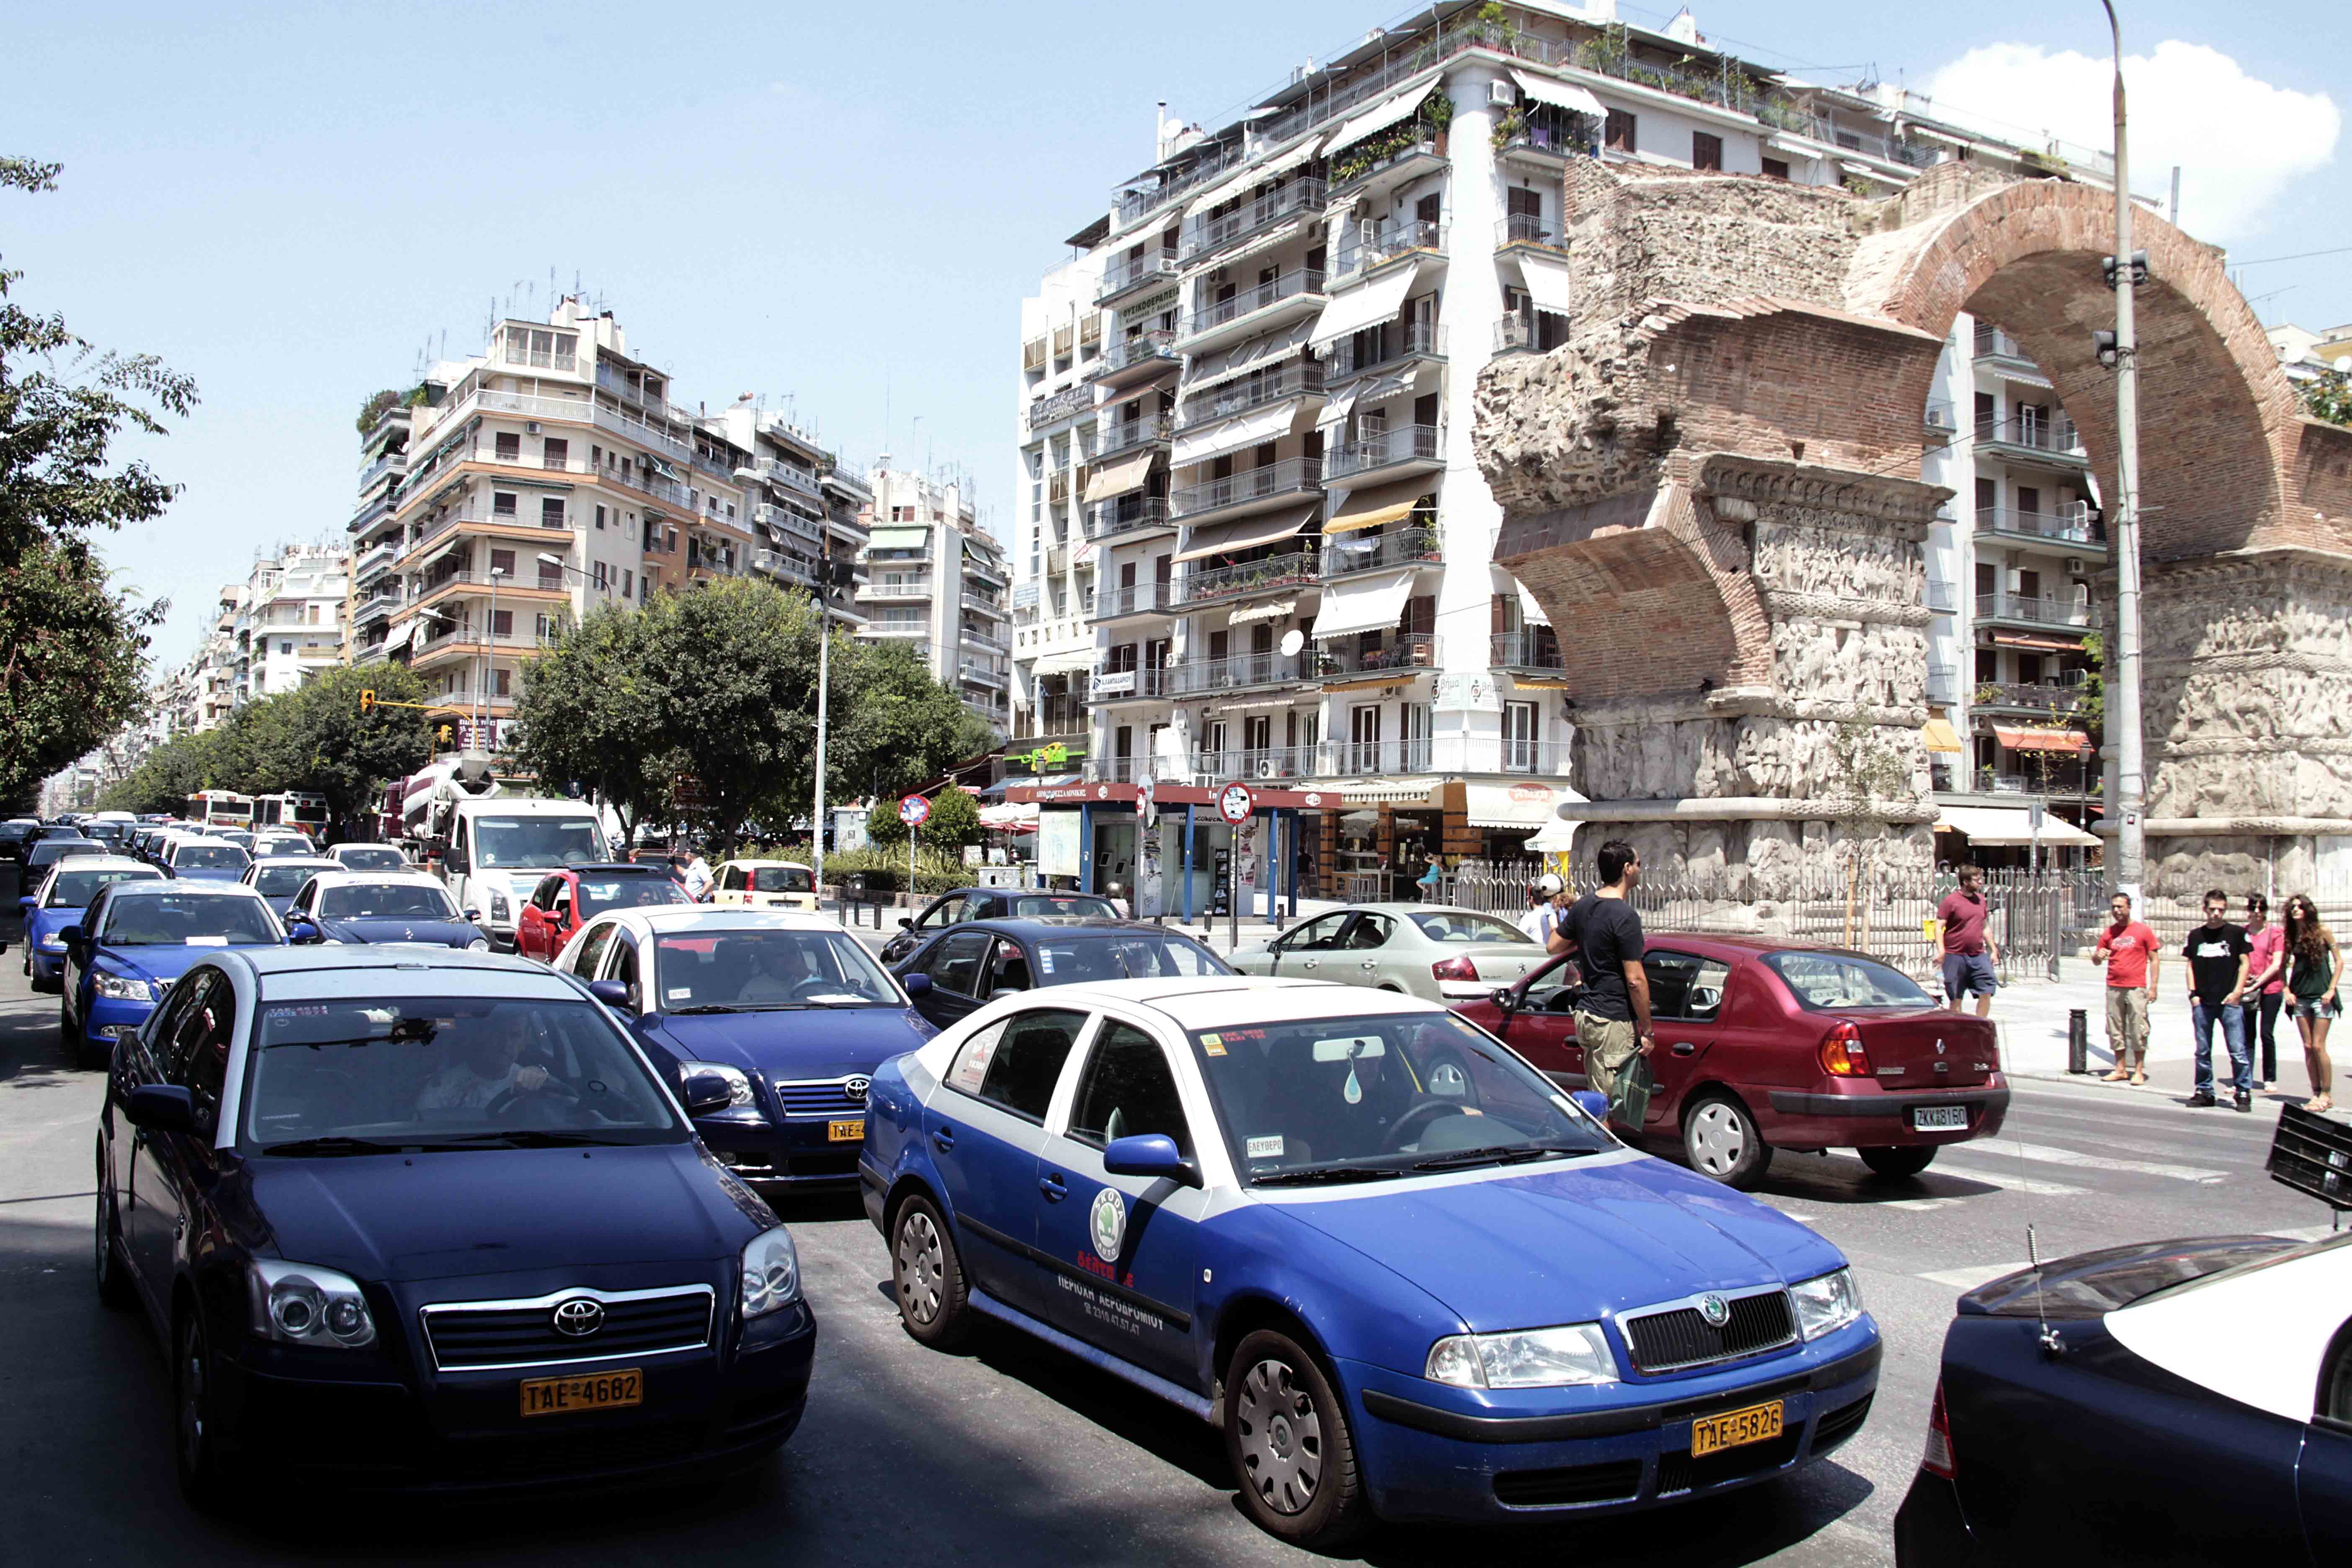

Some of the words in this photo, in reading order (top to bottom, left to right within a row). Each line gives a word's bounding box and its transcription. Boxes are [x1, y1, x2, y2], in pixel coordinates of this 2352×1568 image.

[1441, 678, 1459, 690] βήμα
[1482, 682, 1503, 694] βήμα
[1248, 1139, 1282, 1153] ΕΛΕΥΘΕΡΟ
